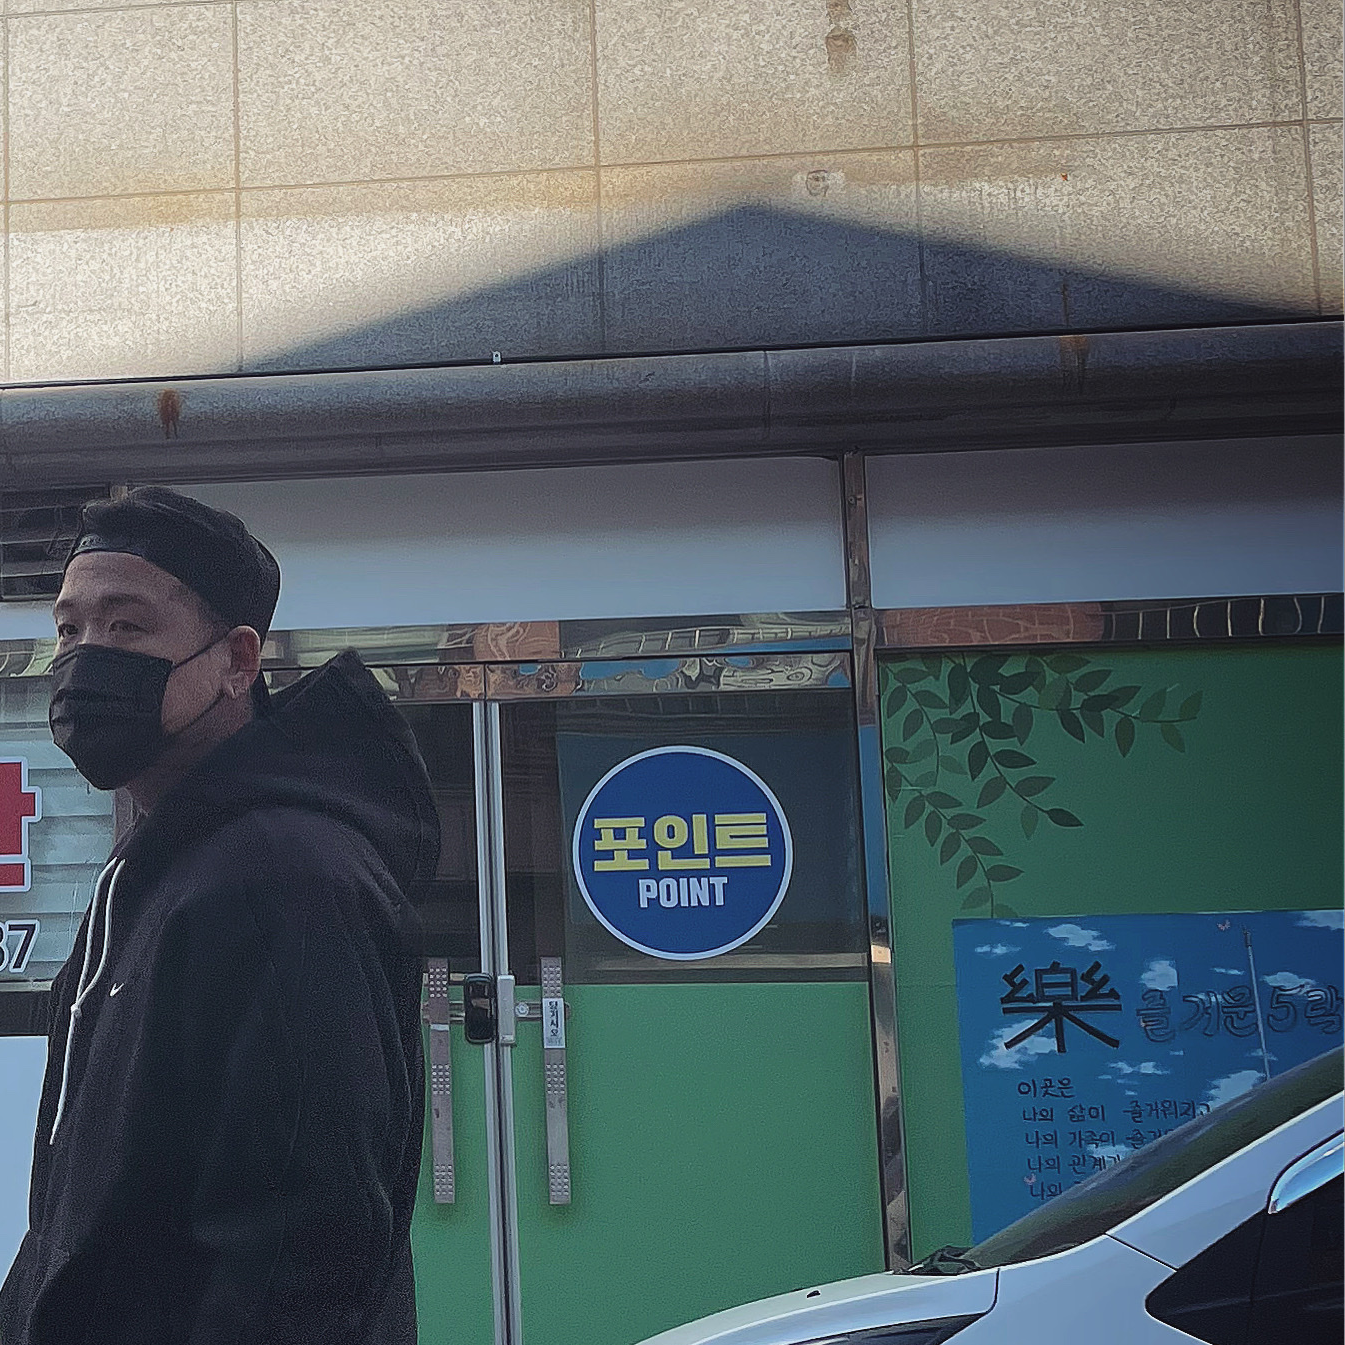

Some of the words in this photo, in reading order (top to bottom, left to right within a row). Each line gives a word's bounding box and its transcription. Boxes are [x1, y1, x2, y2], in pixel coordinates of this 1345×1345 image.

[594, 812, 772, 872] 포인트
[638, 876, 728, 908] POINT
[1000, 960, 1122, 1053] 樂
[1022, 1106, 1054, 1122] 나의
[1067, 1103, 1105, 1122] 삶이
[1025, 1129, 1058, 1149] 나의
[1067, 1129, 1115, 1149] 가족이
[1027, 1155, 1061, 1174] 나의
[1030, 1181, 1063, 1200] 나의
